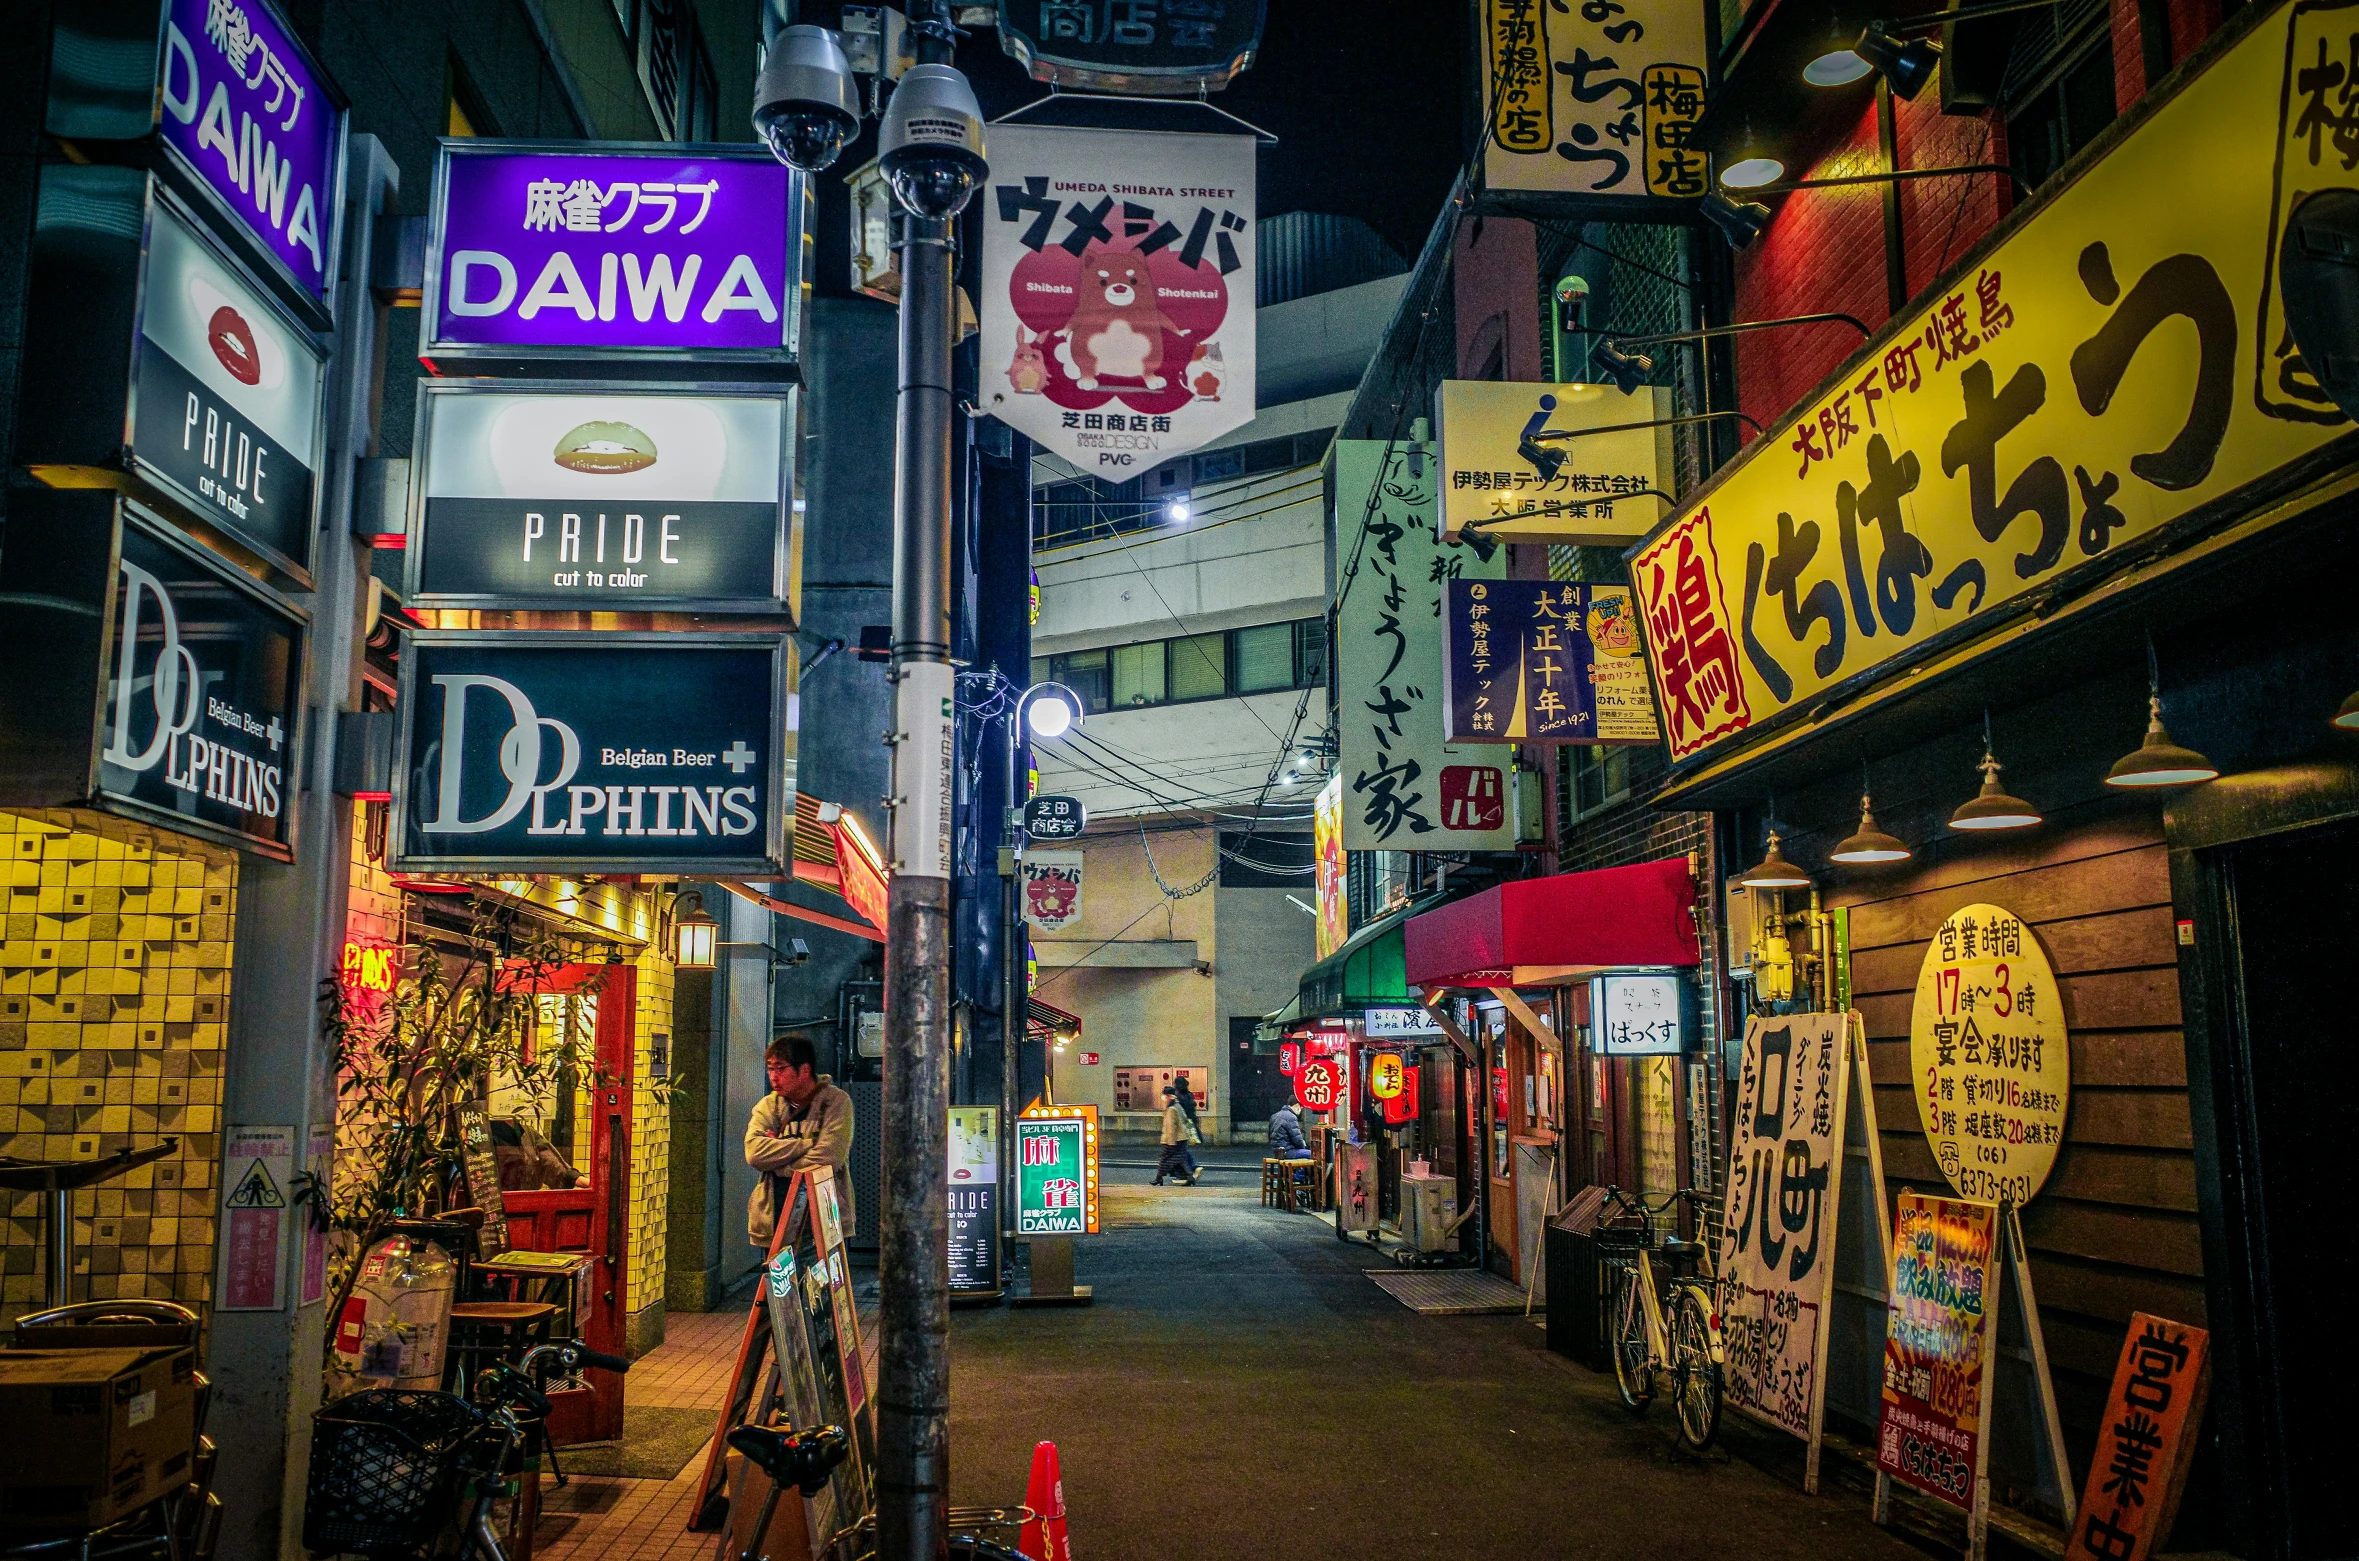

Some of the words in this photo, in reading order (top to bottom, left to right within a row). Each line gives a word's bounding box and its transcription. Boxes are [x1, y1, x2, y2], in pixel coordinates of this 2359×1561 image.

[163, 20, 322, 273] DAIWA
[1648, 71, 1703, 196] 梅田店
[523, 178, 719, 234] 麻雀クラブ
[1054, 182, 1106, 194] UMEDA
[1113, 184, 1174, 197] SHIBATA
[1180, 187, 1235, 199] STREET
[996, 176, 1247, 276] ウメシバ
[449, 250, 778, 323] DAIWA
[1026, 282, 1073, 295] Shibata
[1157, 287, 1219, 300] Shotenkai
[1791, 270, 2015, 481] 大阪下町焼鳥
[1061, 411, 1171, 433] 芝田商店街
[1105, 433, 1159, 450] DESIGN
[183, 391, 268, 504] PRIDE
[1452, 470, 1649, 494] 伊勢屋テック株式会社
[1740, 240, 2239, 705] くちはっちょう
[199, 475, 215, 498] cut
[217, 486, 227, 506] to
[228, 491, 249, 521] color
[1491, 498, 1613, 519] 大阪営業所
[523, 513, 680, 564] PRIDE
[553, 570, 580, 587] cut
[586, 571, 603, 587] to
[608, 568, 649, 588] color
[1560, 585, 1582, 633] 創業
[1587, 595, 1625, 612] FRESH
[1353, 513, 1438, 836] ぎょうざ家
[1468, 604, 1492, 712] 伊勢屋テック
[1532, 590, 1567, 722] 大正十年
[207, 696, 241, 728] Belgian
[242, 707, 265, 738] Beer
[1597, 695, 1626, 706] のれん
[1538, 719, 1566, 734] since
[1566, 711, 1590, 728] 1921
[601, 748, 667, 770] Belgian
[672, 750, 716, 767] Beer
[1031, 817, 1076, 833] 商店会
[1038, 801, 1070, 815] 芝田
[1023, 862, 1081, 884] ウメシバ
[1939, 916, 2021, 963] 営業時間
[1934, 1016, 2045, 1073] 宴会承ります
[1305, 1065, 1330, 1104] 九州
[1383, 1064, 1400, 1091] おでん
[1790, 1036, 1811, 1130] ダイニング
[1811, 1029, 1835, 1138] 炭火焼
[1927, 1066, 1955, 1101] 2階
[1963, 1073, 2061, 1112] 貸切り16名様まで
[1930, 1102, 1956, 1137] 3階
[1960, 1167, 2031, 1202] 6373-6031
[1022, 1217, 1081, 1231] DAIWA
[1895, 1251, 1984, 1316] 飲み放題
[1774, 1289, 1799, 1323] 名物
[1767, 1318, 1788, 1355] とり
[1764, 1354, 1810, 1401] ぎょうざ
[2083, 1322, 2190, 1561] 営業中
